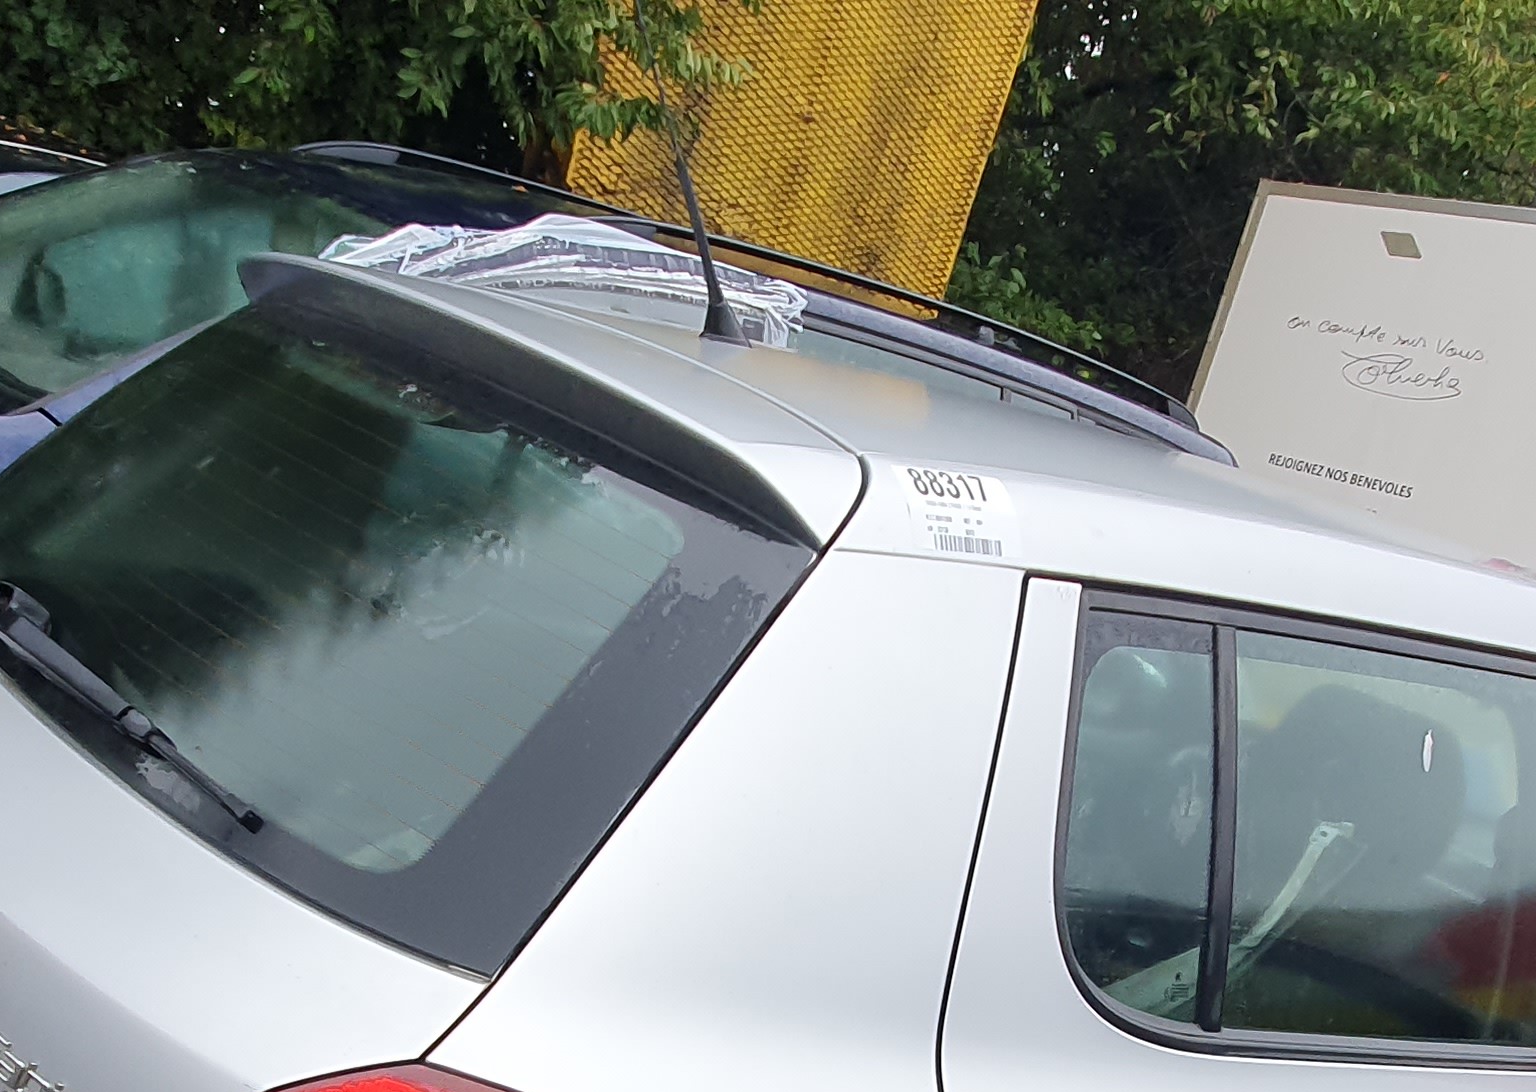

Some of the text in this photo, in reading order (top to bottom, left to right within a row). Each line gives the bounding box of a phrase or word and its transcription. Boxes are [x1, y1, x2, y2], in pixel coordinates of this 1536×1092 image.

[906, 467, 988, 503] 88317
[1268, 452, 1414, 499] REJOIGNEZ NOS BENEVOLES
